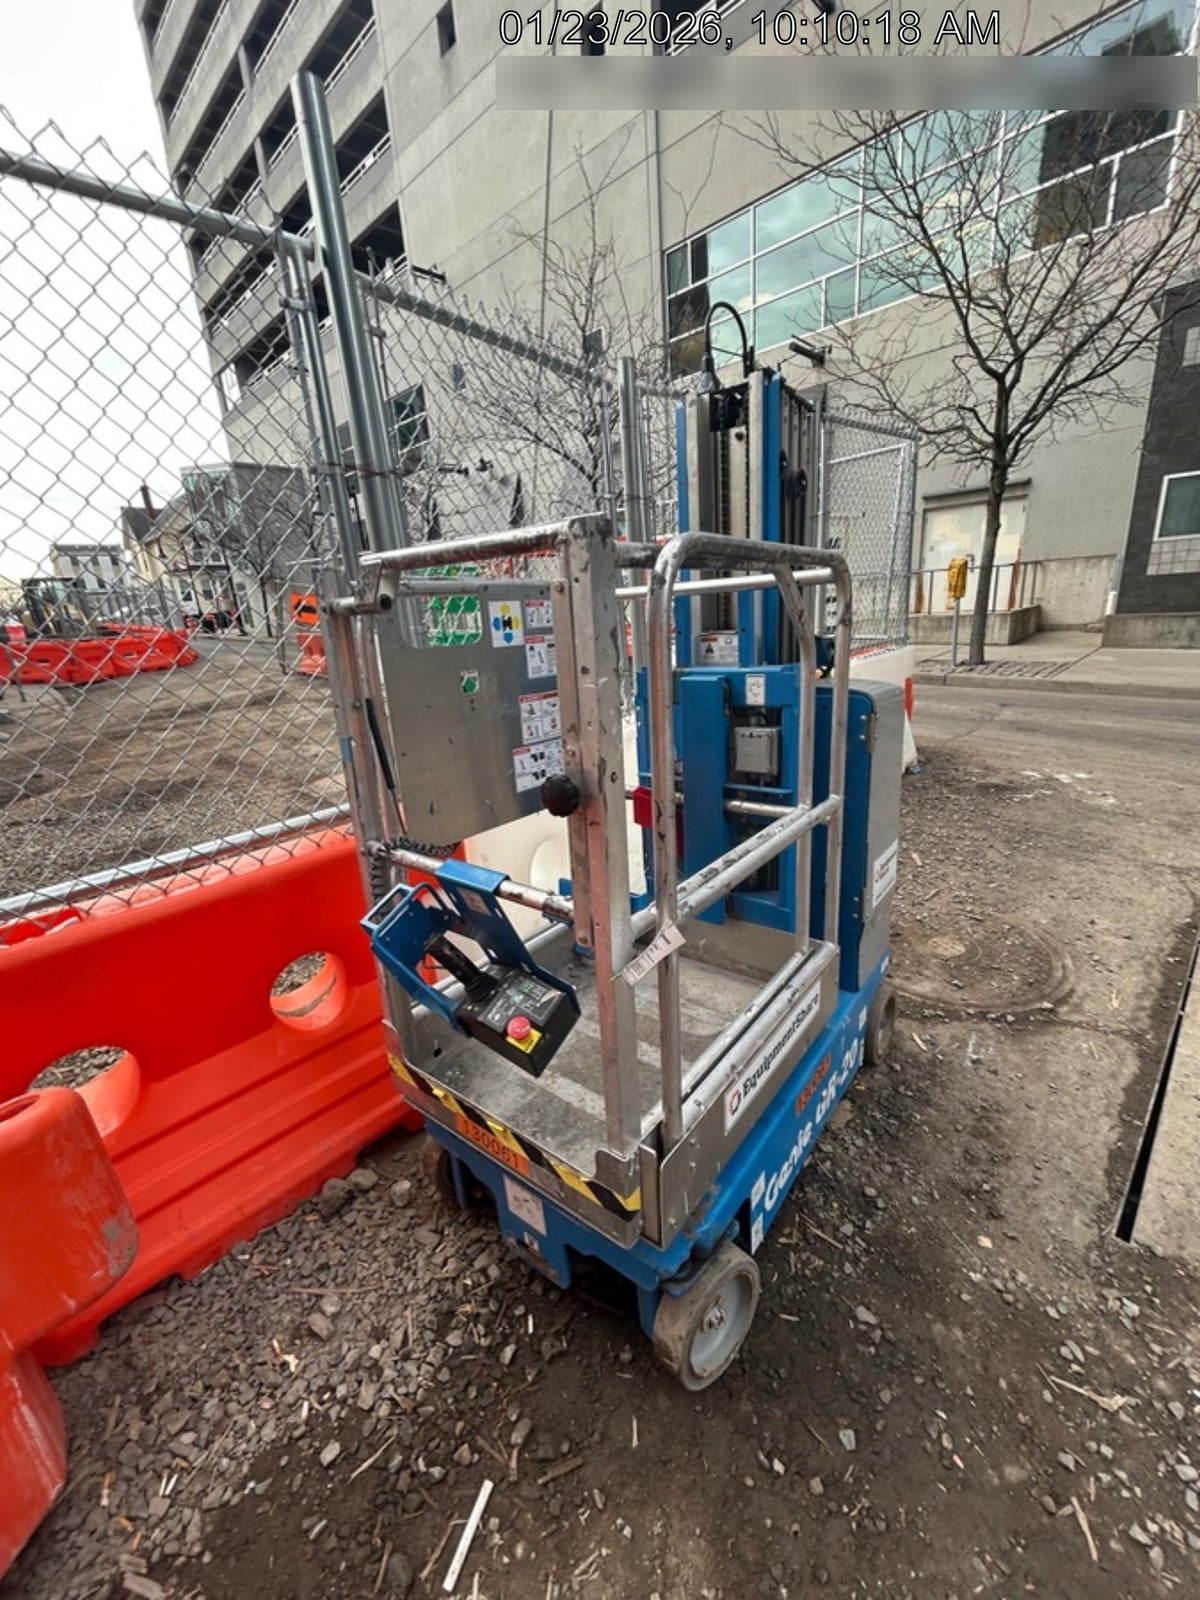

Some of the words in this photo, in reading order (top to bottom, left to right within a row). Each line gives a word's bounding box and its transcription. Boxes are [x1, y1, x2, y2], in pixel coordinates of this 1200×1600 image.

[742, 992, 819, 1098] EquipmentShare
[462, 1118, 520, 1169] 130061
[764, 1121, 813, 1212] Genie
